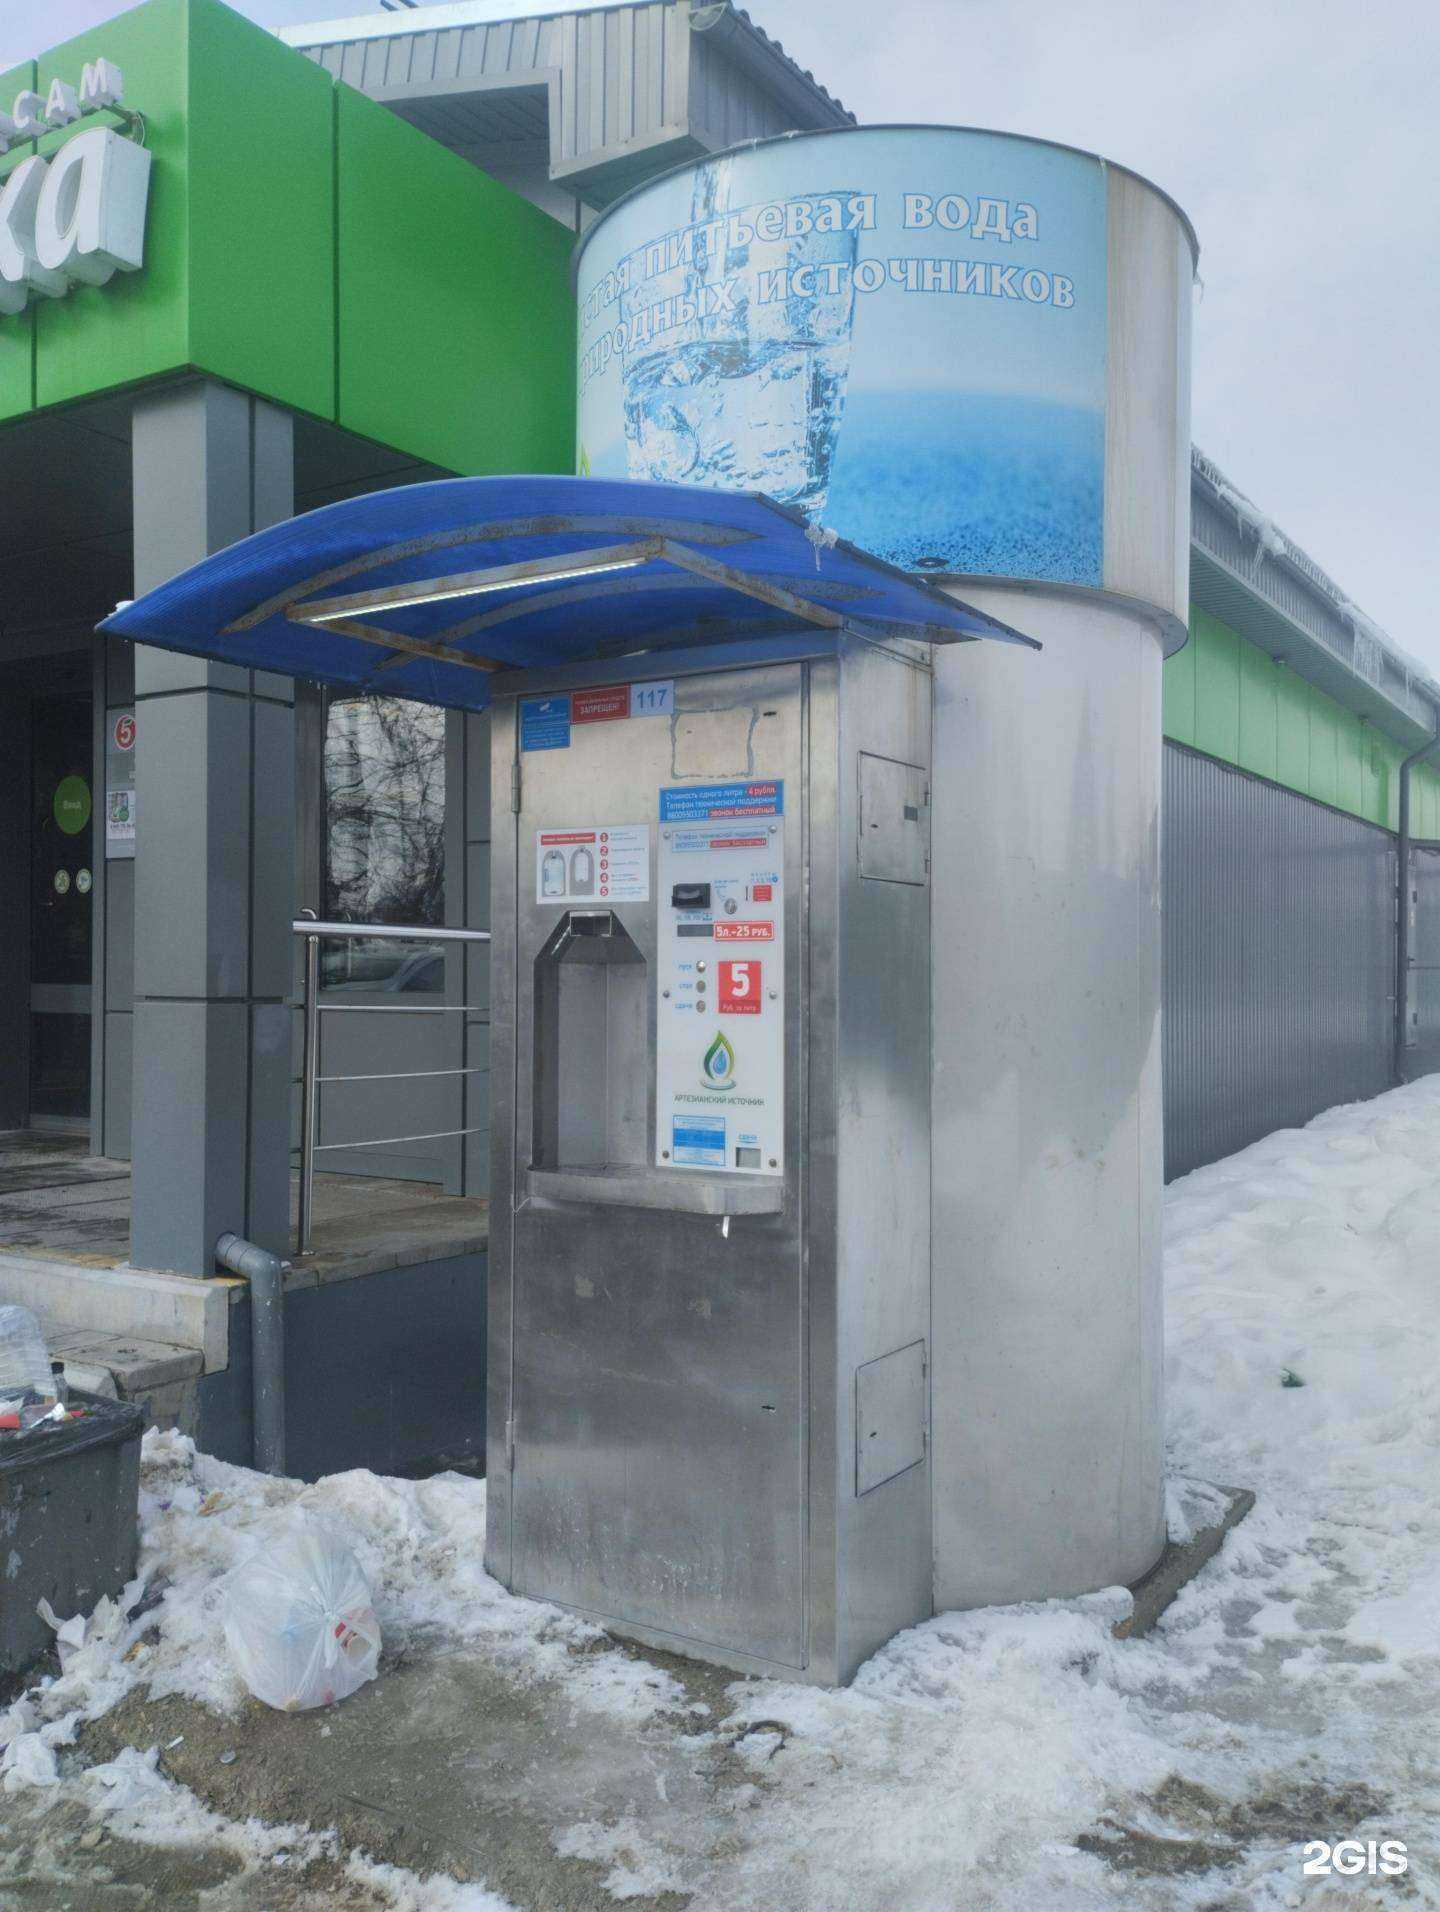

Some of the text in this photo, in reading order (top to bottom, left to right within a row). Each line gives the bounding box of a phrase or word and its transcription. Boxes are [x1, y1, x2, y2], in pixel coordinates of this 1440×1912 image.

[644, 193, 877, 281] питьевая
[903, 193, 1040, 243] вода
[757, 257, 1075, 309] источников
[636, 688, 667, 709] 117
[731, 963, 750, 997] 5
[674, 1094, 727, 1104] АРТЕЗИАНСКИЙ
